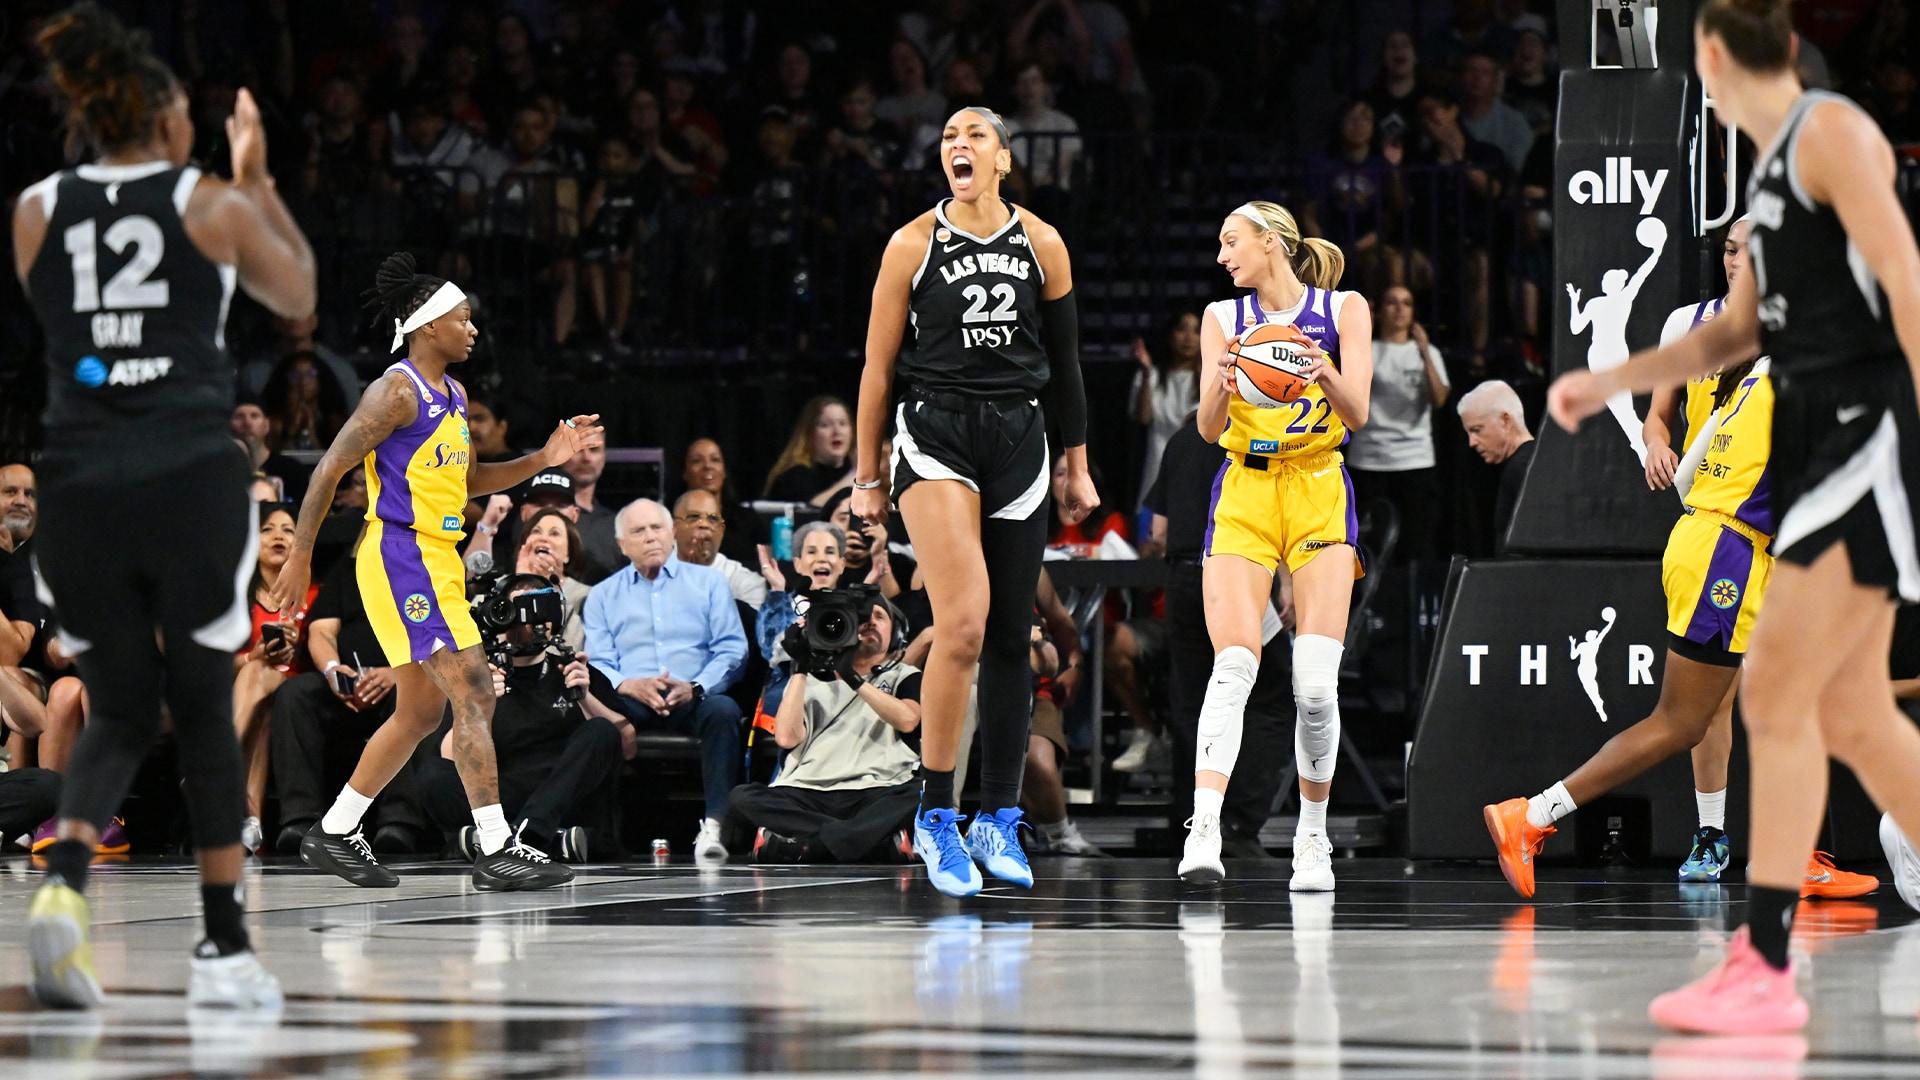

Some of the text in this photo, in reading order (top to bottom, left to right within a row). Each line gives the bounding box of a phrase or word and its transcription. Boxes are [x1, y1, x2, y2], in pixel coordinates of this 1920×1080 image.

[1568, 156, 1669, 215] ally
[1008, 234, 1029, 247] ally
[63, 214, 170, 313] 12
[939, 253, 1030, 285] LAS VEGAS
[961, 282, 1018, 324] 22
[90, 311, 145, 349] GRAY
[961, 325, 1019, 348] IPSY
[1301, 325, 1326, 334] Albert
[1285, 396, 1334, 434] 22
[1720, 377, 1760, 427] 7
[1253, 442, 1275, 451] UCLA
[531, 473, 570, 488] ACES
